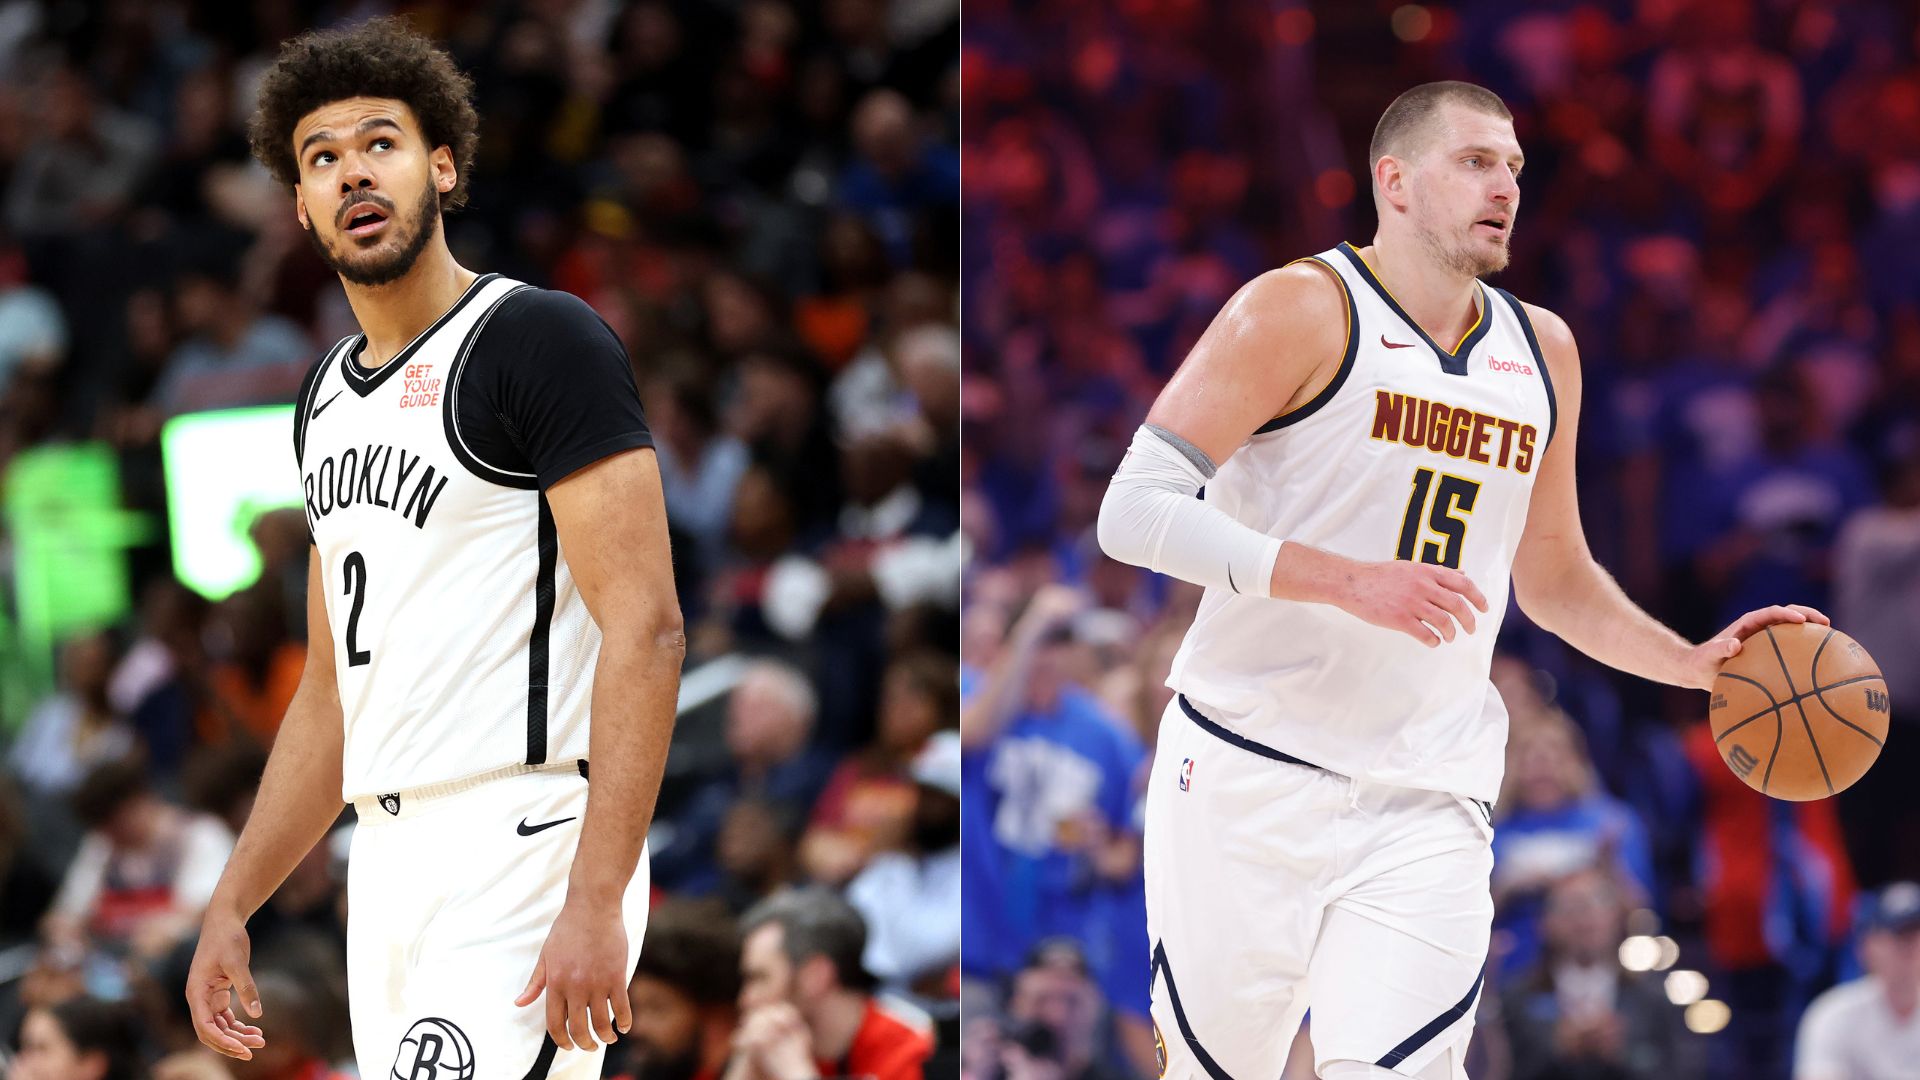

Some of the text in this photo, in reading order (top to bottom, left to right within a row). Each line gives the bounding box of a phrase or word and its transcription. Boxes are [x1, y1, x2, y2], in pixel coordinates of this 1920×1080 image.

[403, 378, 441, 394] YOUR
[405, 364, 433, 379] GET
[1488, 355, 1533, 376] ibotta
[399, 393, 440, 408] GUIDE
[1370, 389, 1538, 475] NUGGETS
[304, 444, 449, 530] ROOKLYN
[1394, 465, 1483, 570] 15
[343, 551, 371, 668] 2
